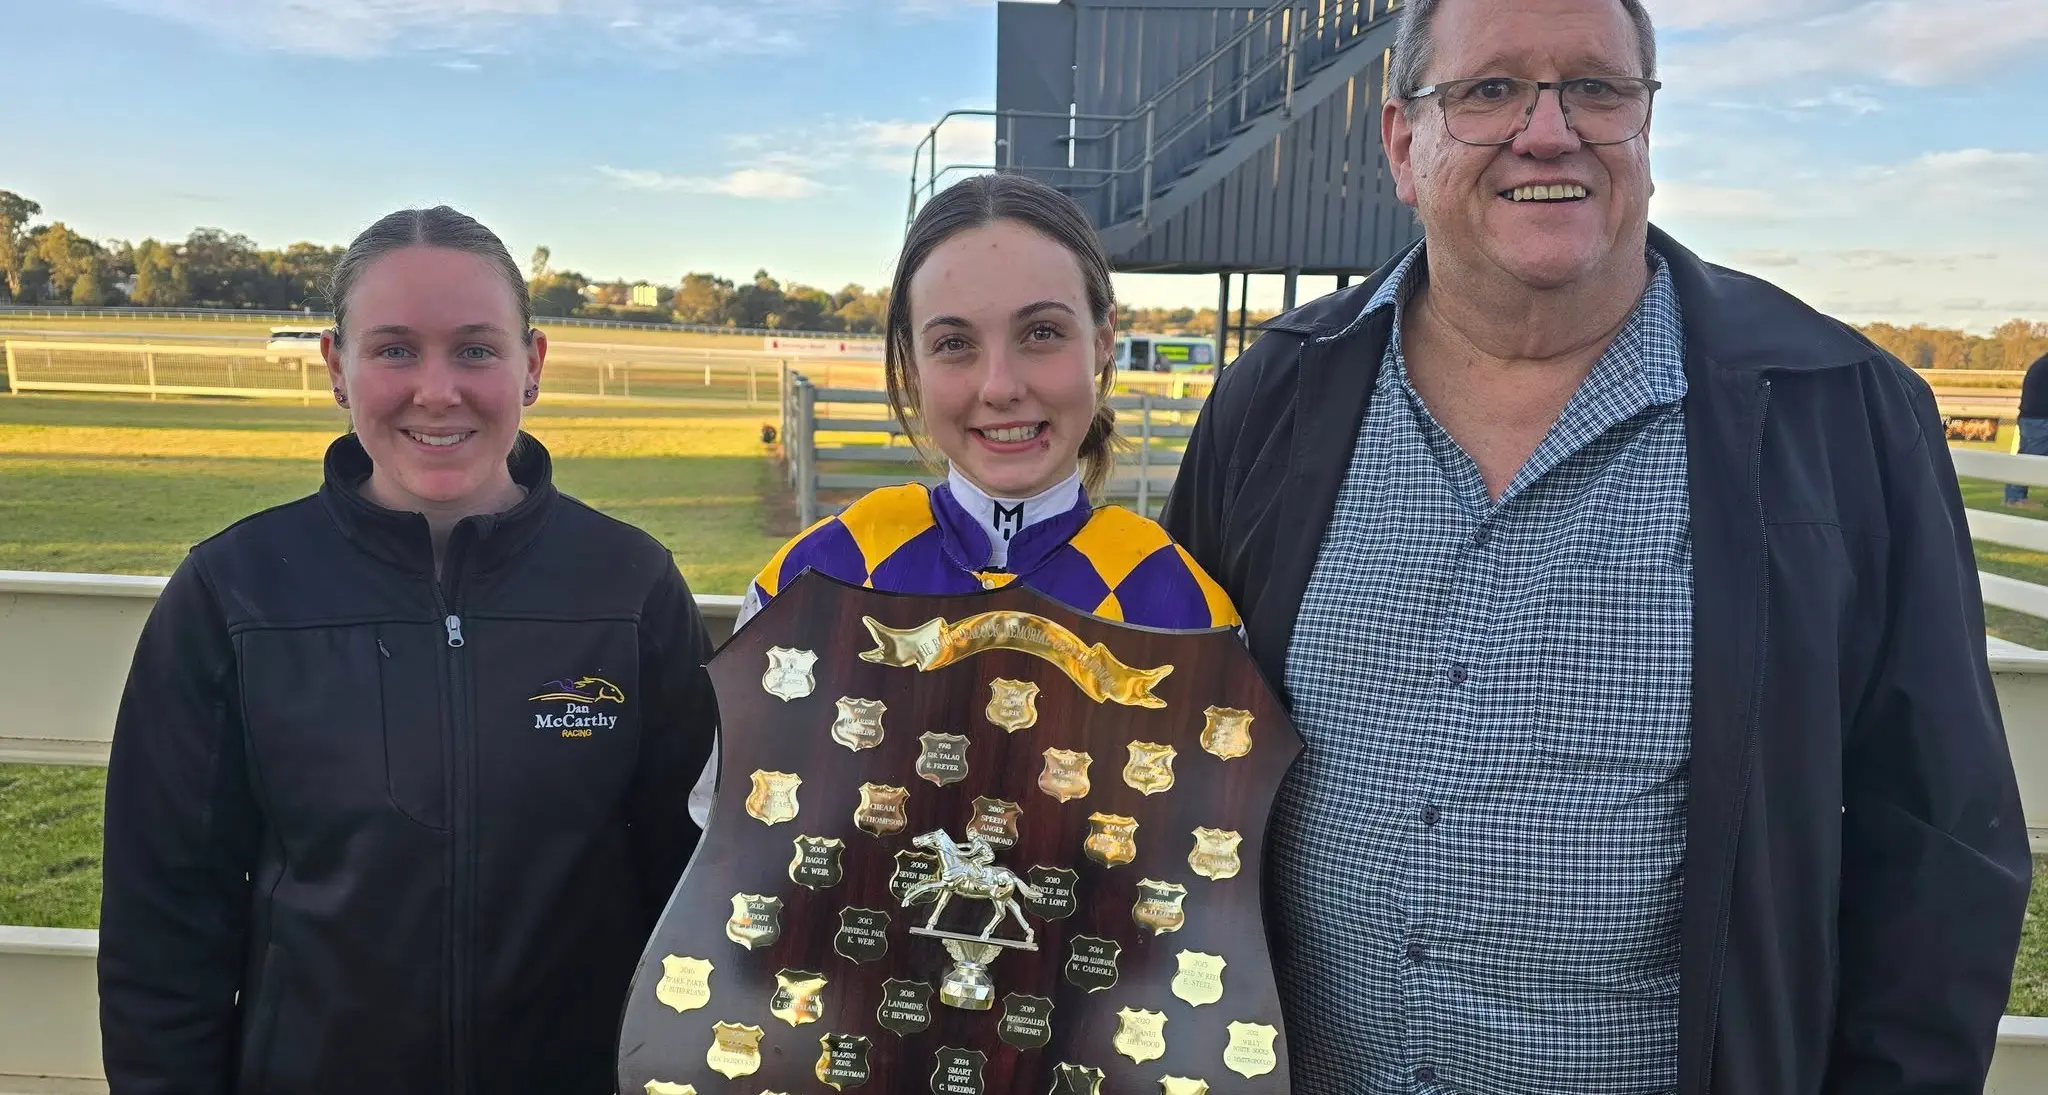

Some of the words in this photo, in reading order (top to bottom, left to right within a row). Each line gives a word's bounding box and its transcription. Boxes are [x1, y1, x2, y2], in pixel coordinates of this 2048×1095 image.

[566, 703, 590, 714] Dan
[534, 713, 617, 729] McCarthy
[561, 729, 592, 738] RACING
[981, 815, 1007, 825] SPEEDY
[981, 825, 1005, 834] ANGEL
[805, 856, 828, 865] BAGGY
[910, 861, 929, 870] 2009
[811, 868, 829, 876] WEIR
[899, 870, 918, 879] SEVEN
[1056, 888, 1070, 897] BEN
[749, 902, 765, 910] 2012
[899, 989, 916, 998] 2018
[888, 999, 924, 1011] LANDMINE
[1019, 1005, 1036, 1014] 2019
[891, 1011, 926, 1023] HEYWOOD
[947, 1066, 973, 1076] SMART
[947, 1074, 970, 1084] POPPY
